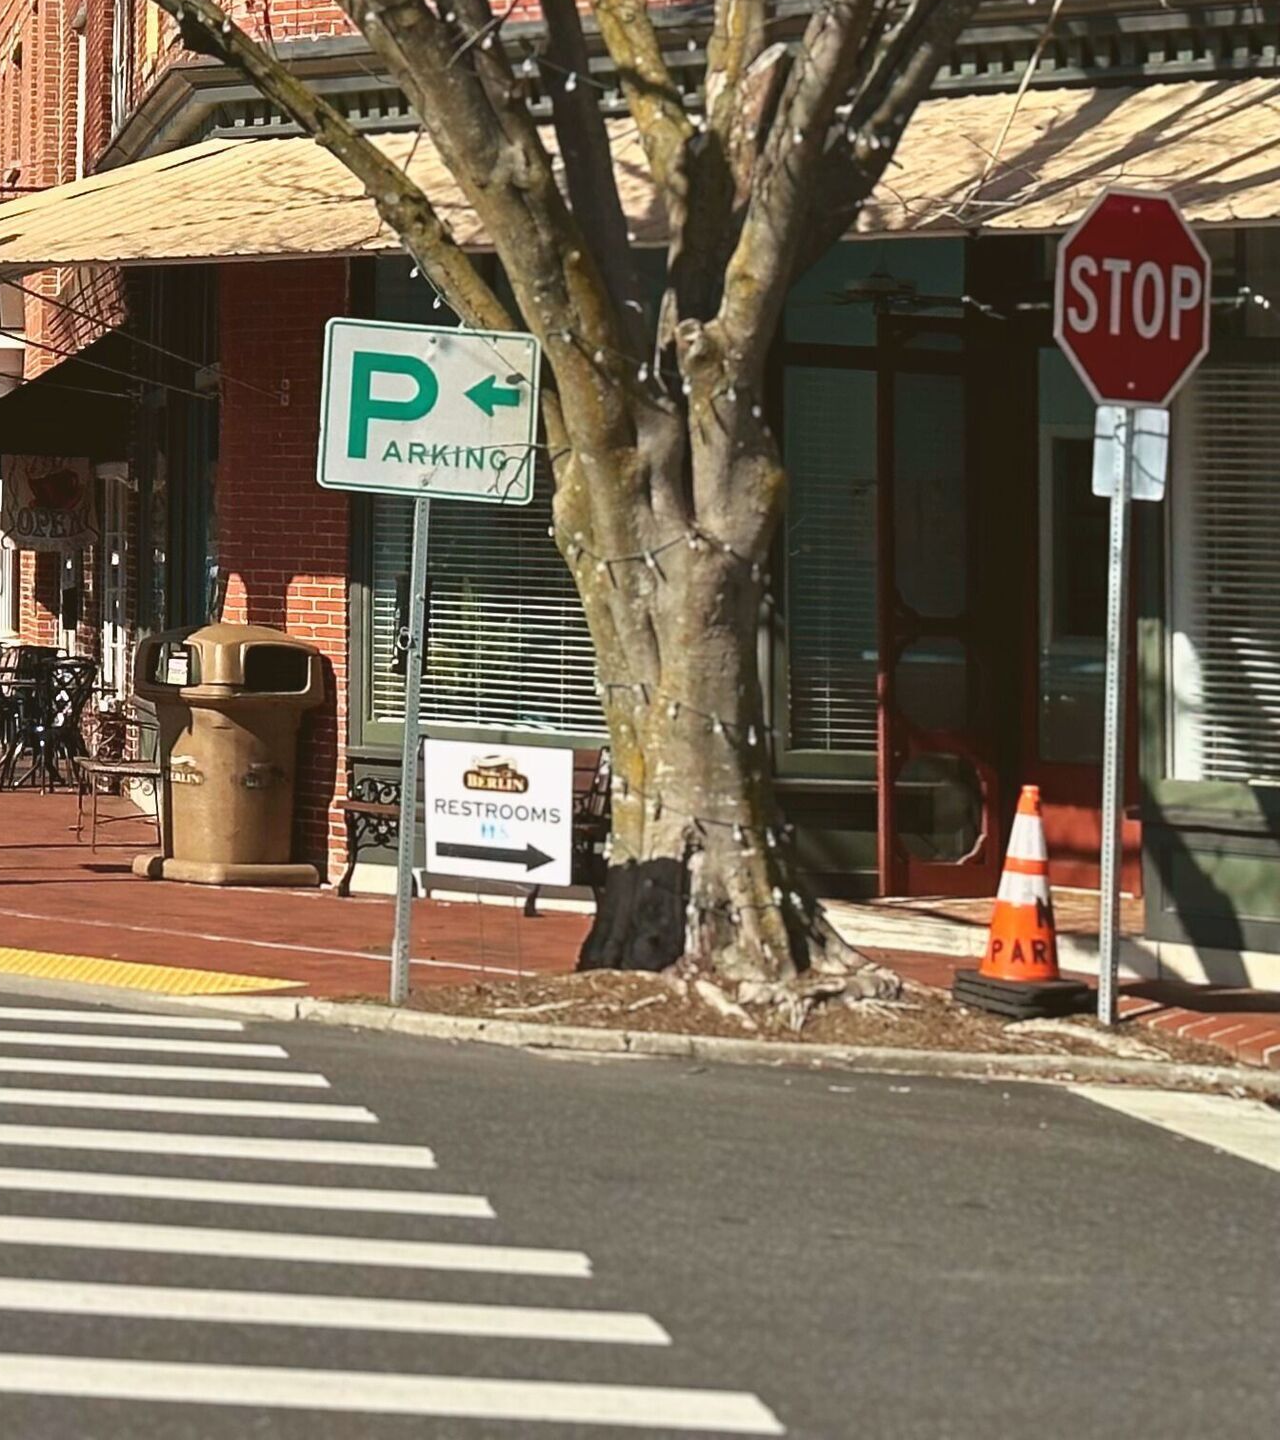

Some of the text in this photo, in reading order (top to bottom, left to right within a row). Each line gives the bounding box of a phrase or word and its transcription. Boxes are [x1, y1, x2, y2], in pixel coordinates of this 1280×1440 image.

[1067, 254, 1202, 341] STOP
[466, 772, 525, 791] BERLIN
[434, 797, 562, 824] RESTROOMS
